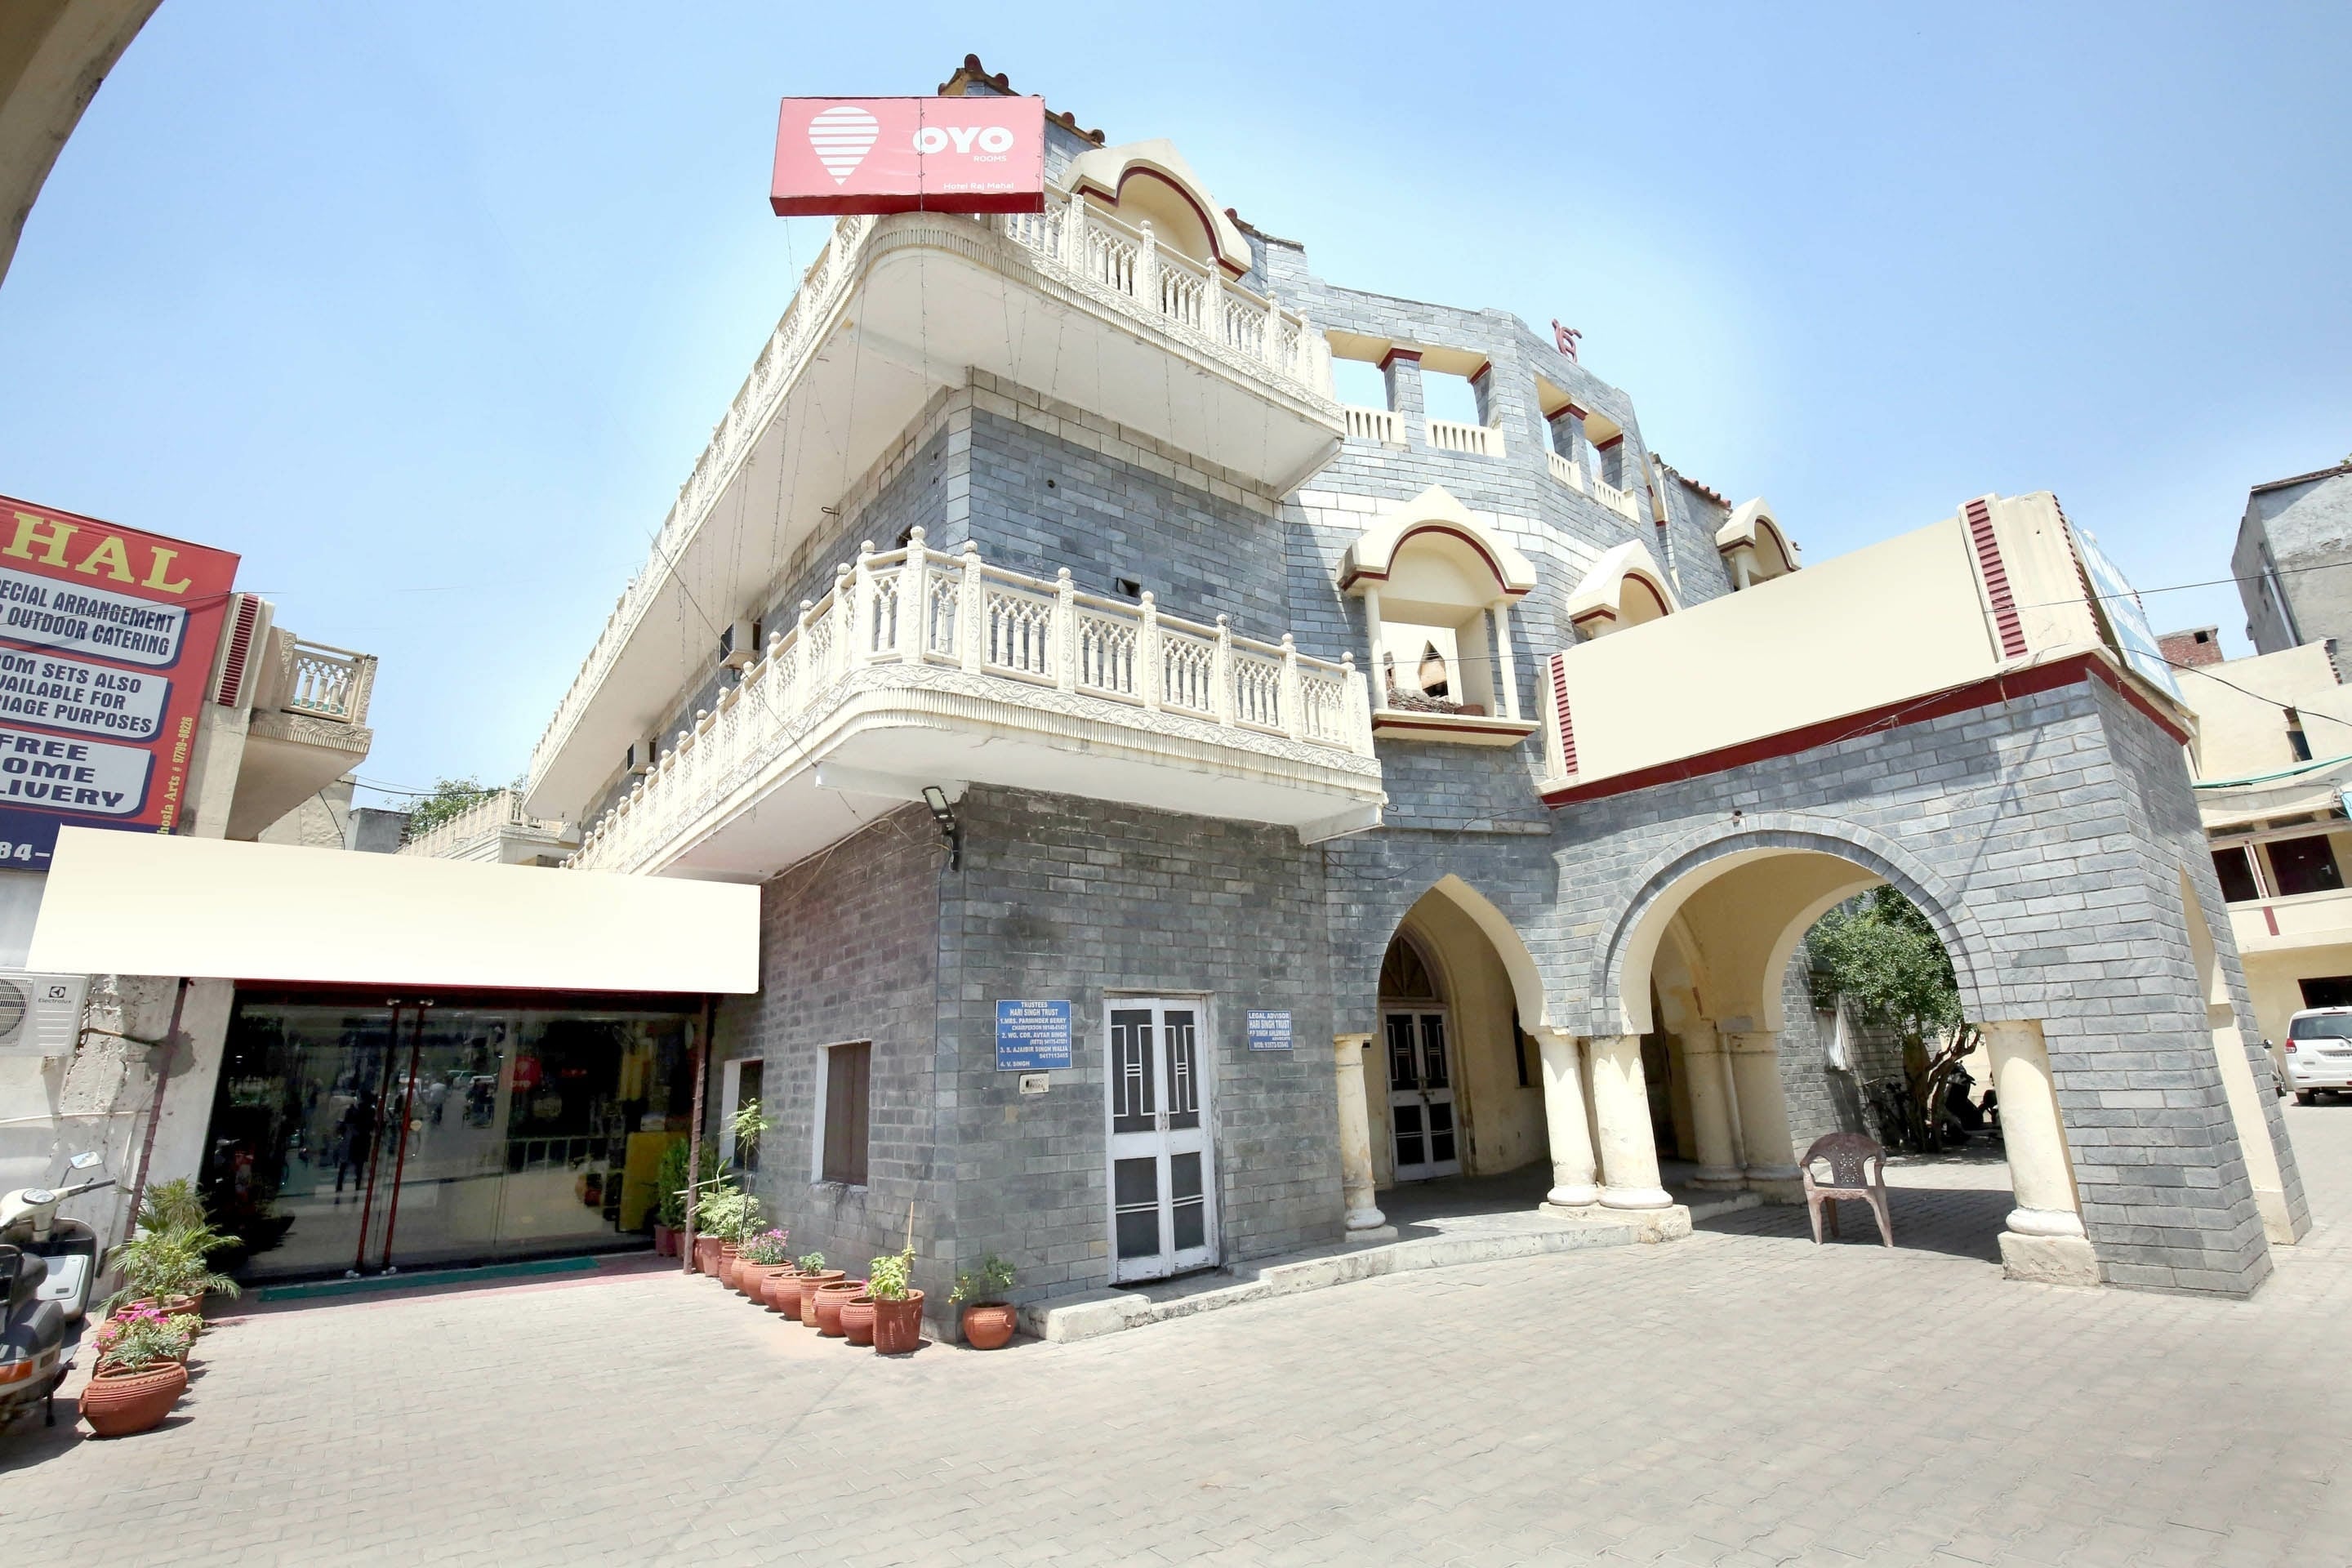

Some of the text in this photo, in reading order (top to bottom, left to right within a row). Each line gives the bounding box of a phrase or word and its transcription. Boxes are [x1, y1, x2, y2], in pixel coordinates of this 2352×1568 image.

[912, 127, 1014, 154] OYO
[970, 182, 985, 190] Raj
[2, 511, 192, 595] HAL
[0, 578, 176, 634] ECIAL ARRANGEMENT
[7, 606, 170, 656] OUTDOOR CATERING
[0, 655, 142, 693] OM SETS ALSO
[0, 694, 153, 733] IAGE PURPOSES
[90, 691, 127, 710] FOR
[0, 733, 89, 762] FREE
[2, 756, 96, 784] OME
[0, 778, 125, 808] IVERY
[164, 775, 180, 801] Arts
[1276, 1019, 1290, 1029] TRUST
